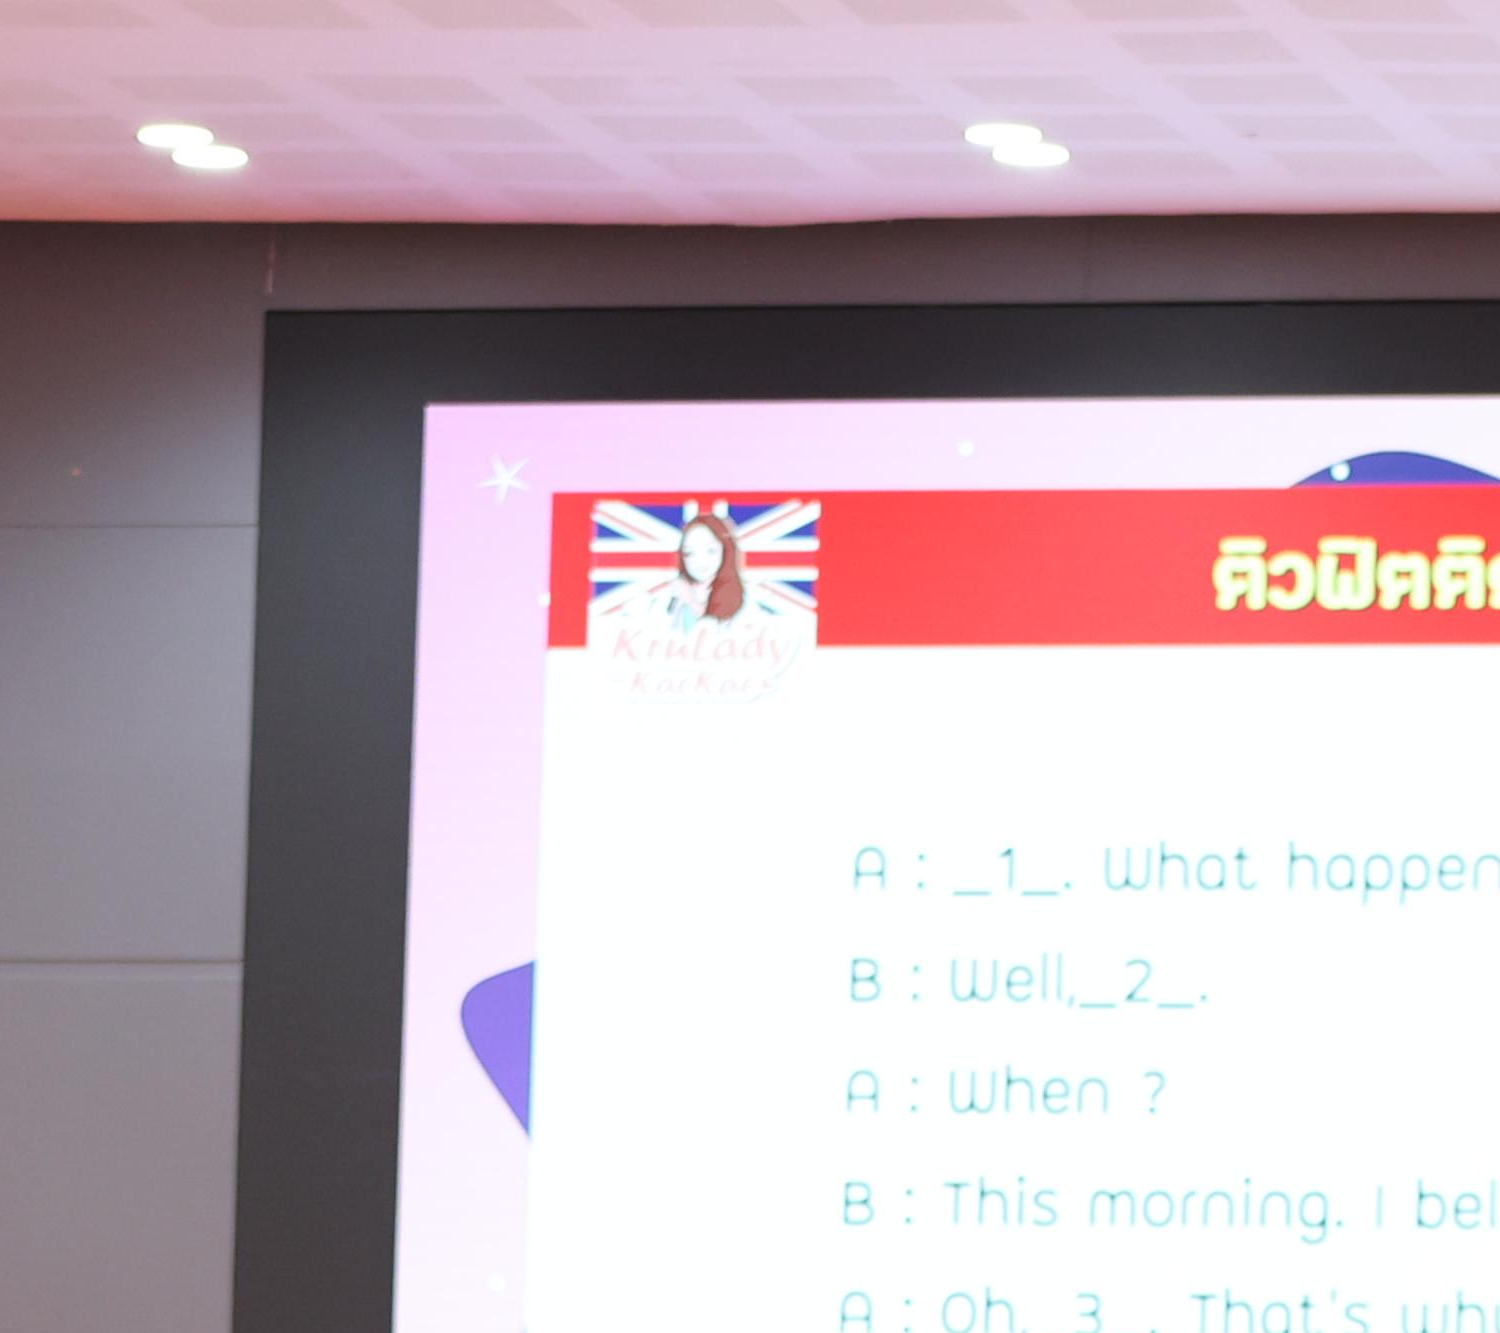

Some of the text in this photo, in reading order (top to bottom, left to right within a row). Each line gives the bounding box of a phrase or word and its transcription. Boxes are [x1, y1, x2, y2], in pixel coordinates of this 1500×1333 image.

[851, 844, 888, 890] A
[1103, 840, 1258, 893] What
[848, 955, 884, 1004] B
[844, 1067, 881, 1113] A
[947, 1063, 1110, 1116] When
[1142, 1069, 1168, 1116] ?
[841, 1178, 877, 1228] B
[942, 1174, 1060, 1228] This
[1088, 1176, 1346, 1247] morning.
